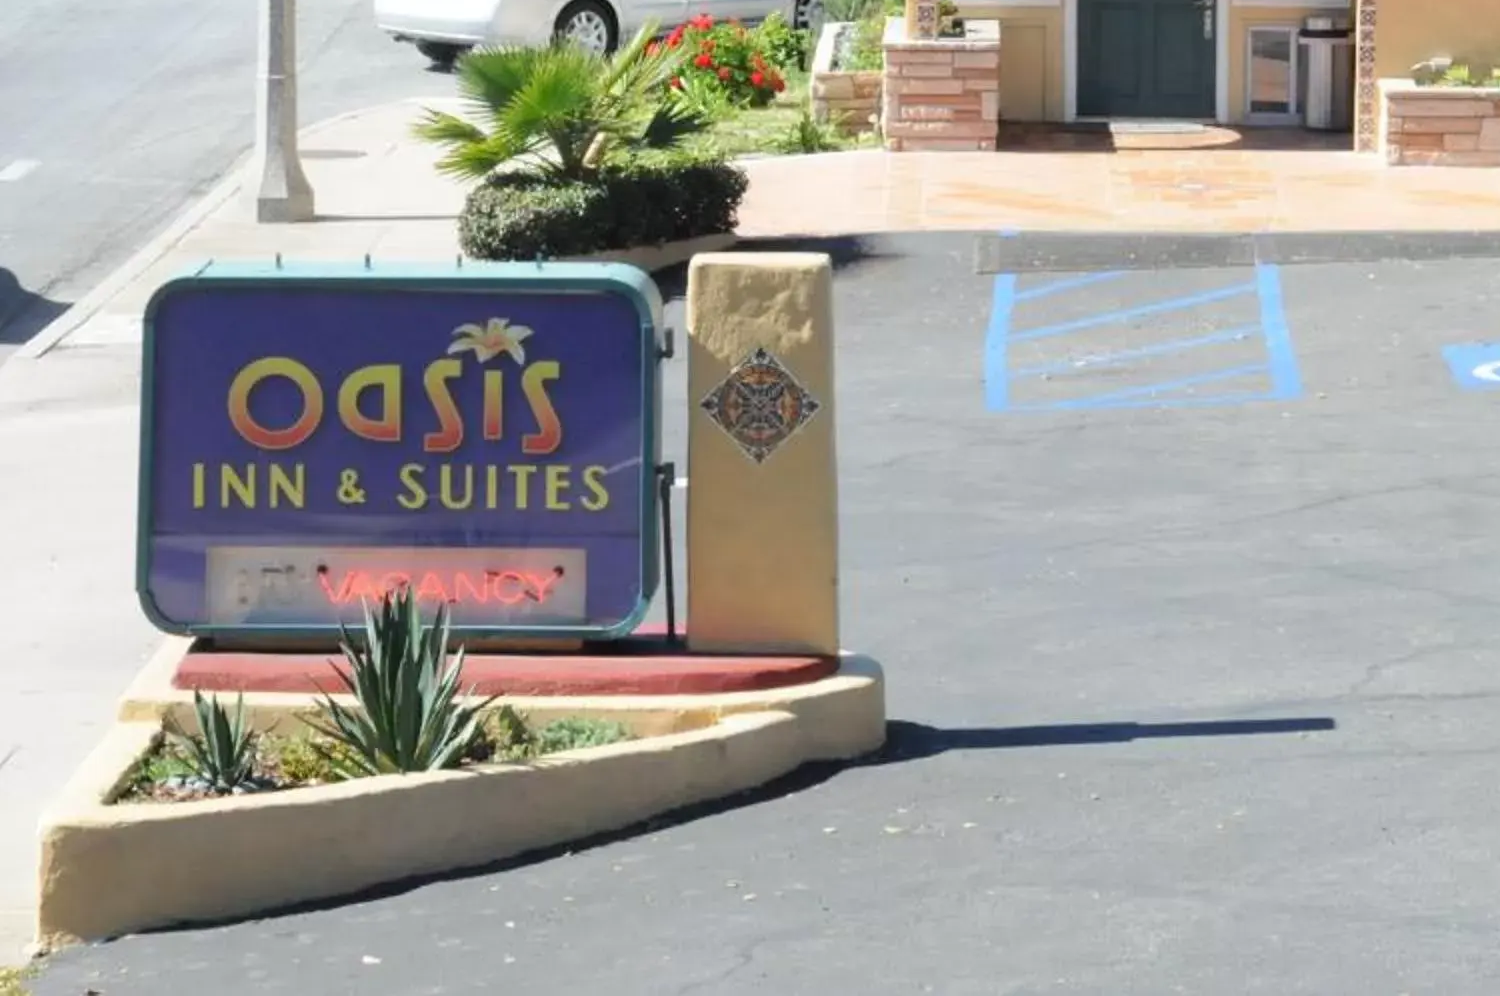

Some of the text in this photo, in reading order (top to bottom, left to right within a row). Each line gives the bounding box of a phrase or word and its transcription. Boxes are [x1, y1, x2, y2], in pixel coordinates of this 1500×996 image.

[193, 462, 610, 511] INN & SUITES
[319, 569, 557, 606] VACANCY
